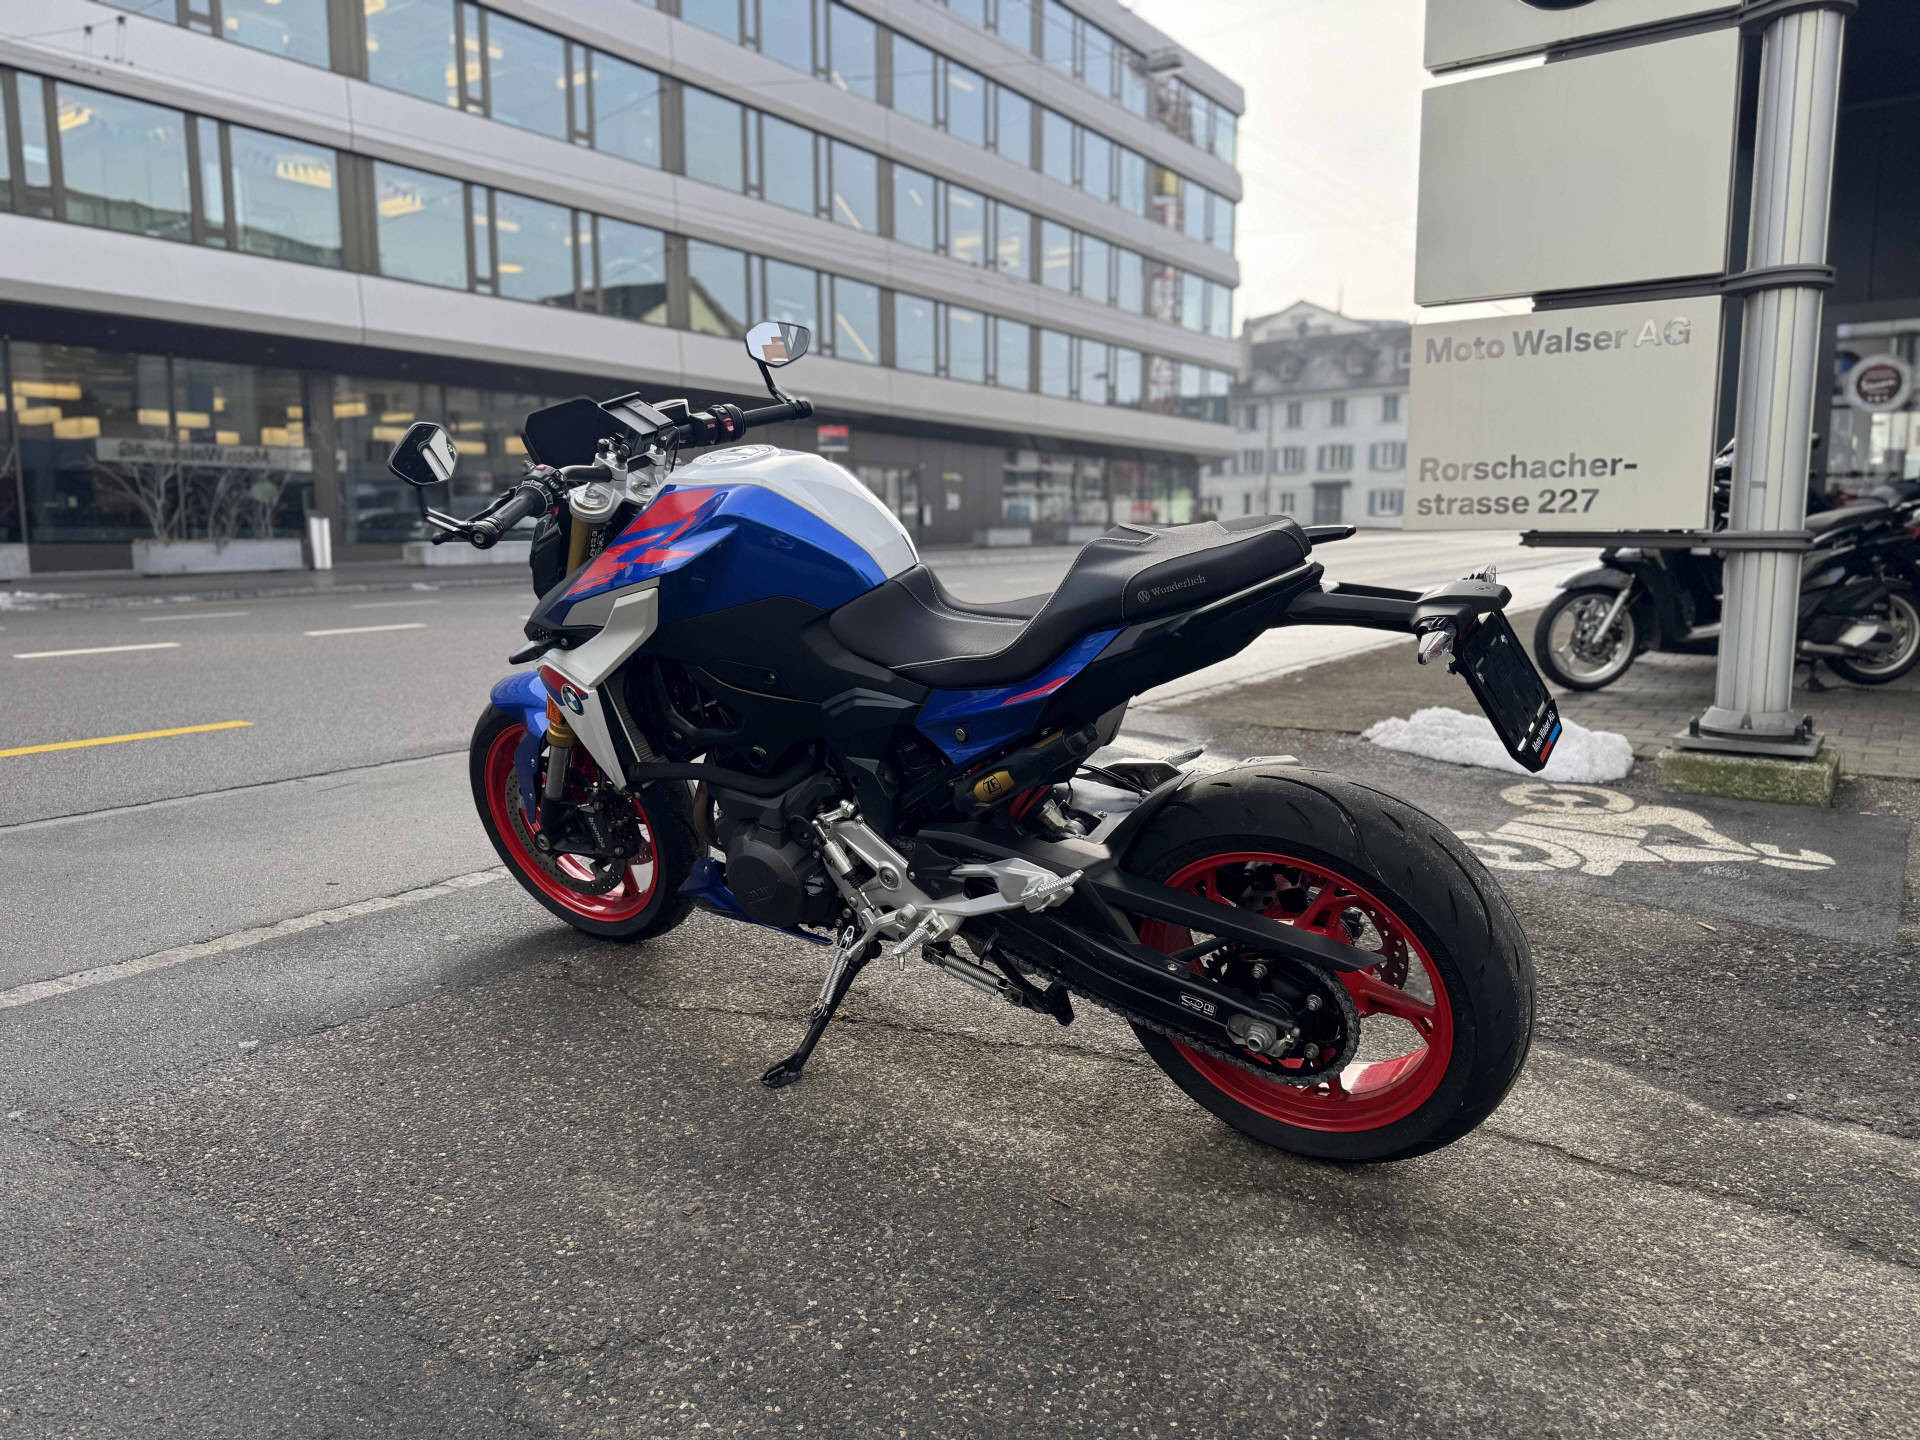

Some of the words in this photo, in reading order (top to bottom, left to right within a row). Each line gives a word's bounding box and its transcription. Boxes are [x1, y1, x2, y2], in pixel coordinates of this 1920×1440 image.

[1425, 337, 1505, 364] Moto
[1513, 327, 1628, 357] Walser
[1634, 316, 1692, 348] AG
[1419, 452, 1638, 483] Rorschacher-
[1417, 491, 1530, 517] strasse
[1537, 488, 1600, 514] 227
[1151, 574, 1207, 597] Wunderlich
[1531, 736, 1543, 753] Moto
[1538, 720, 1551, 740] Walser
[1547, 710, 1555, 724] AG
